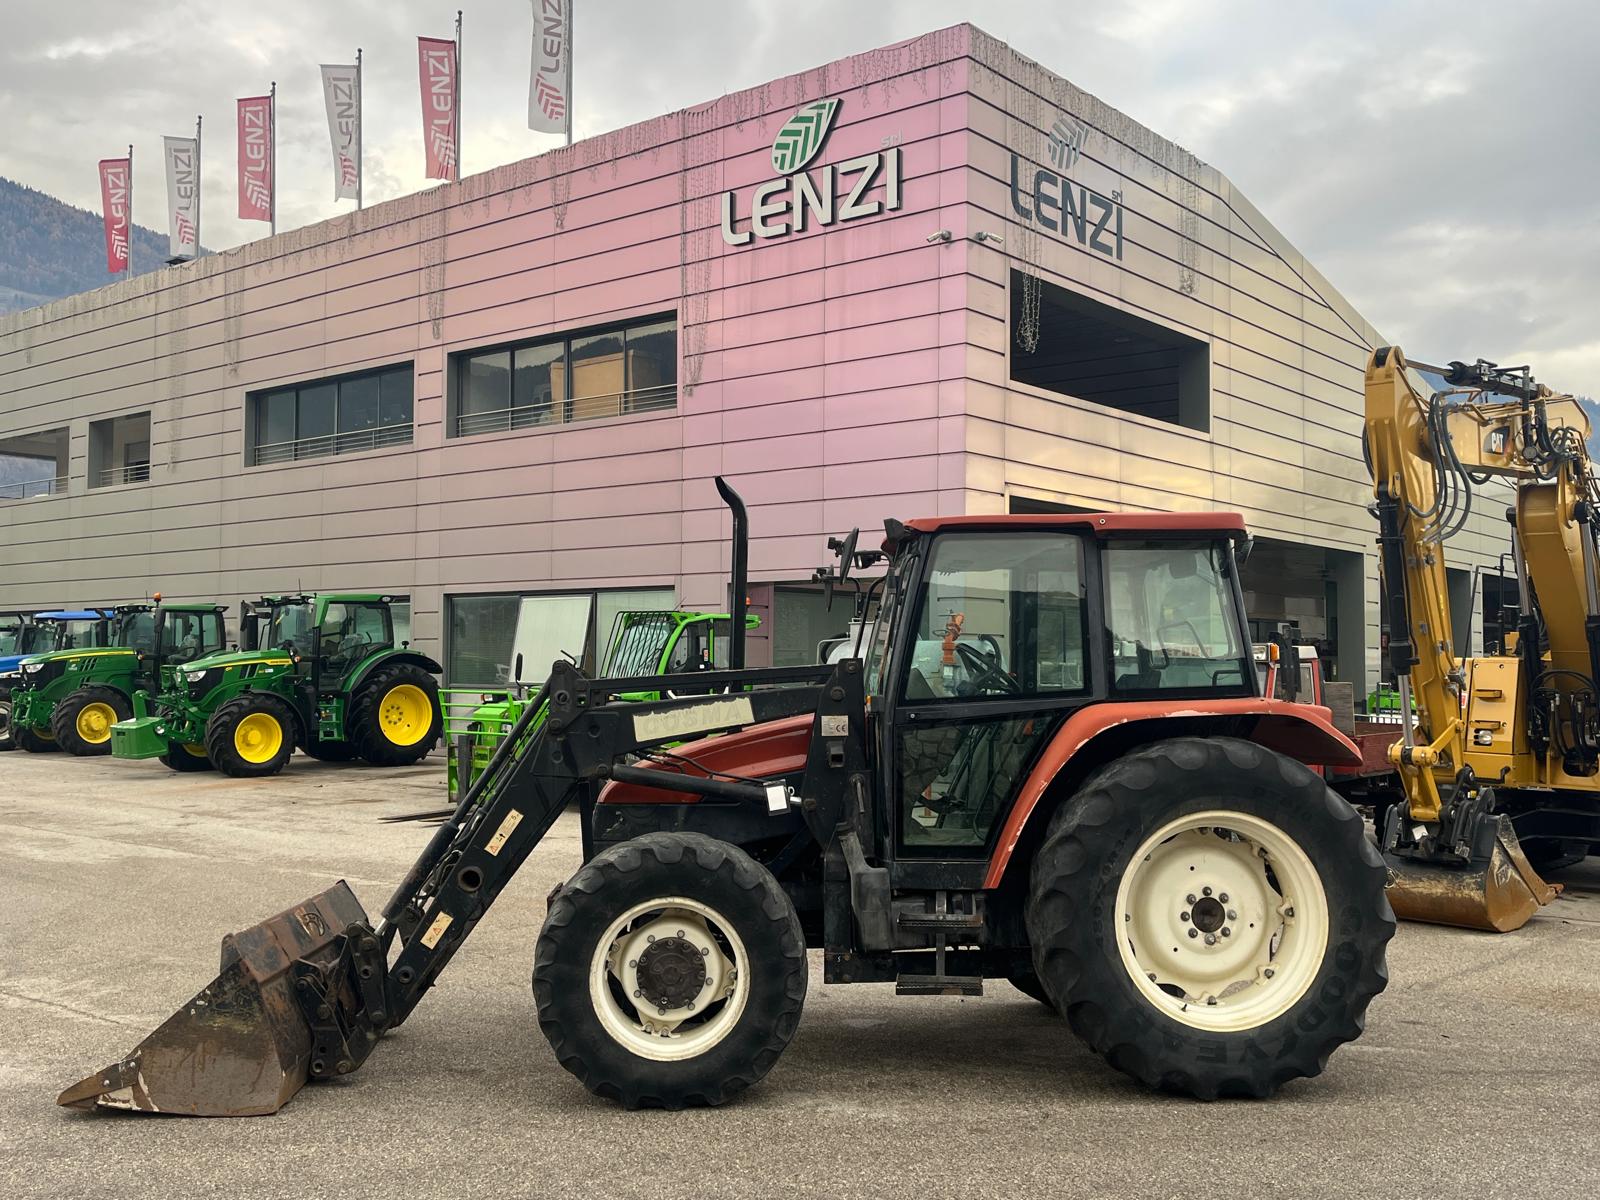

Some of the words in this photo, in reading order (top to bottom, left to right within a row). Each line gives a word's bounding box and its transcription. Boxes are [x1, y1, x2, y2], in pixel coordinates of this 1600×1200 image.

[541, 0, 562, 73] LENZ
[331, 77, 354, 150] LENZI
[428, 50, 452, 124] LENZI
[245, 106, 266, 171] LENZI
[107, 168, 126, 229] LENZI
[173, 148, 193, 210] LENZI
[721, 147, 904, 246] LENZI
[1010, 152, 1123, 261] LENZI
[1491, 432, 1503, 453] CAT
